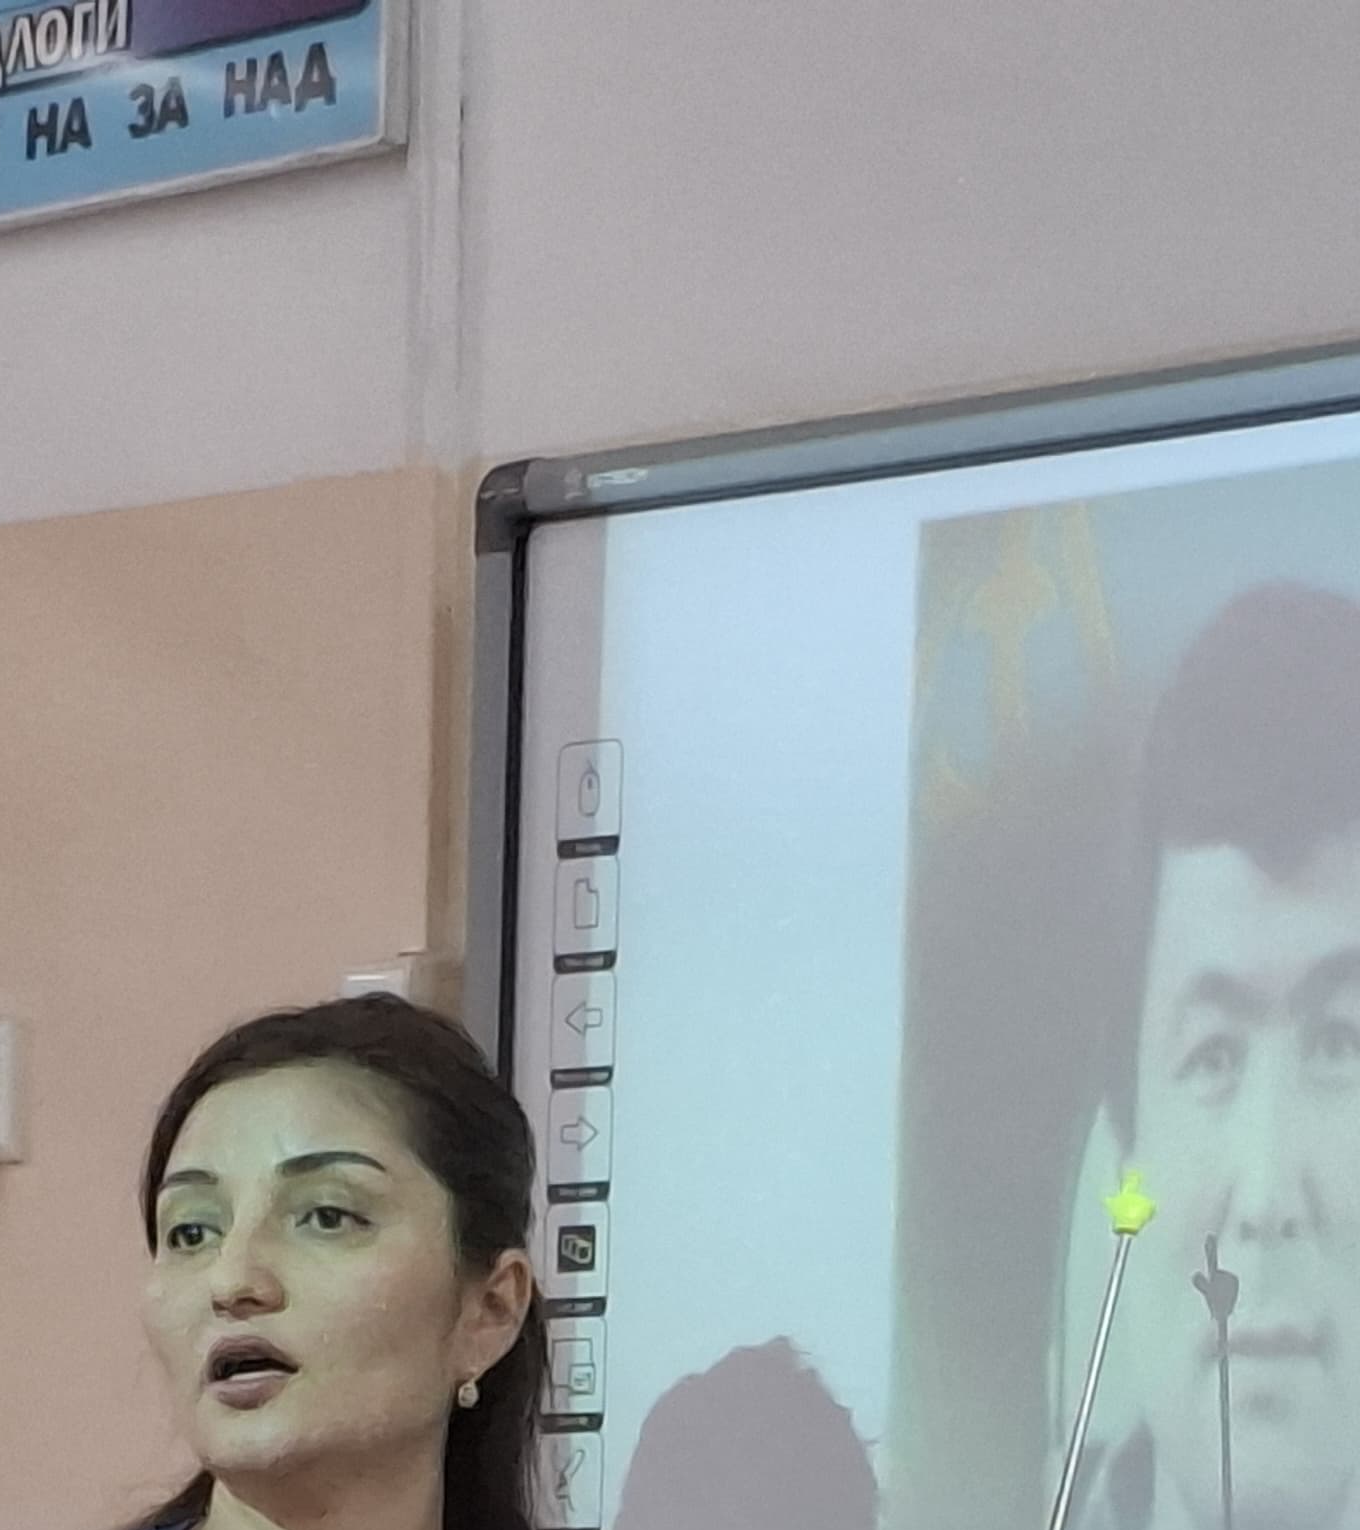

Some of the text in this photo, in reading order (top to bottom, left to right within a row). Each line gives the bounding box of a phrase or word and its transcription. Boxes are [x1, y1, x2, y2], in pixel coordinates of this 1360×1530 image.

[26, 96, 92, 160] НА
[128, 76, 189, 139] ЗА
[223, 41, 337, 119] НАД
